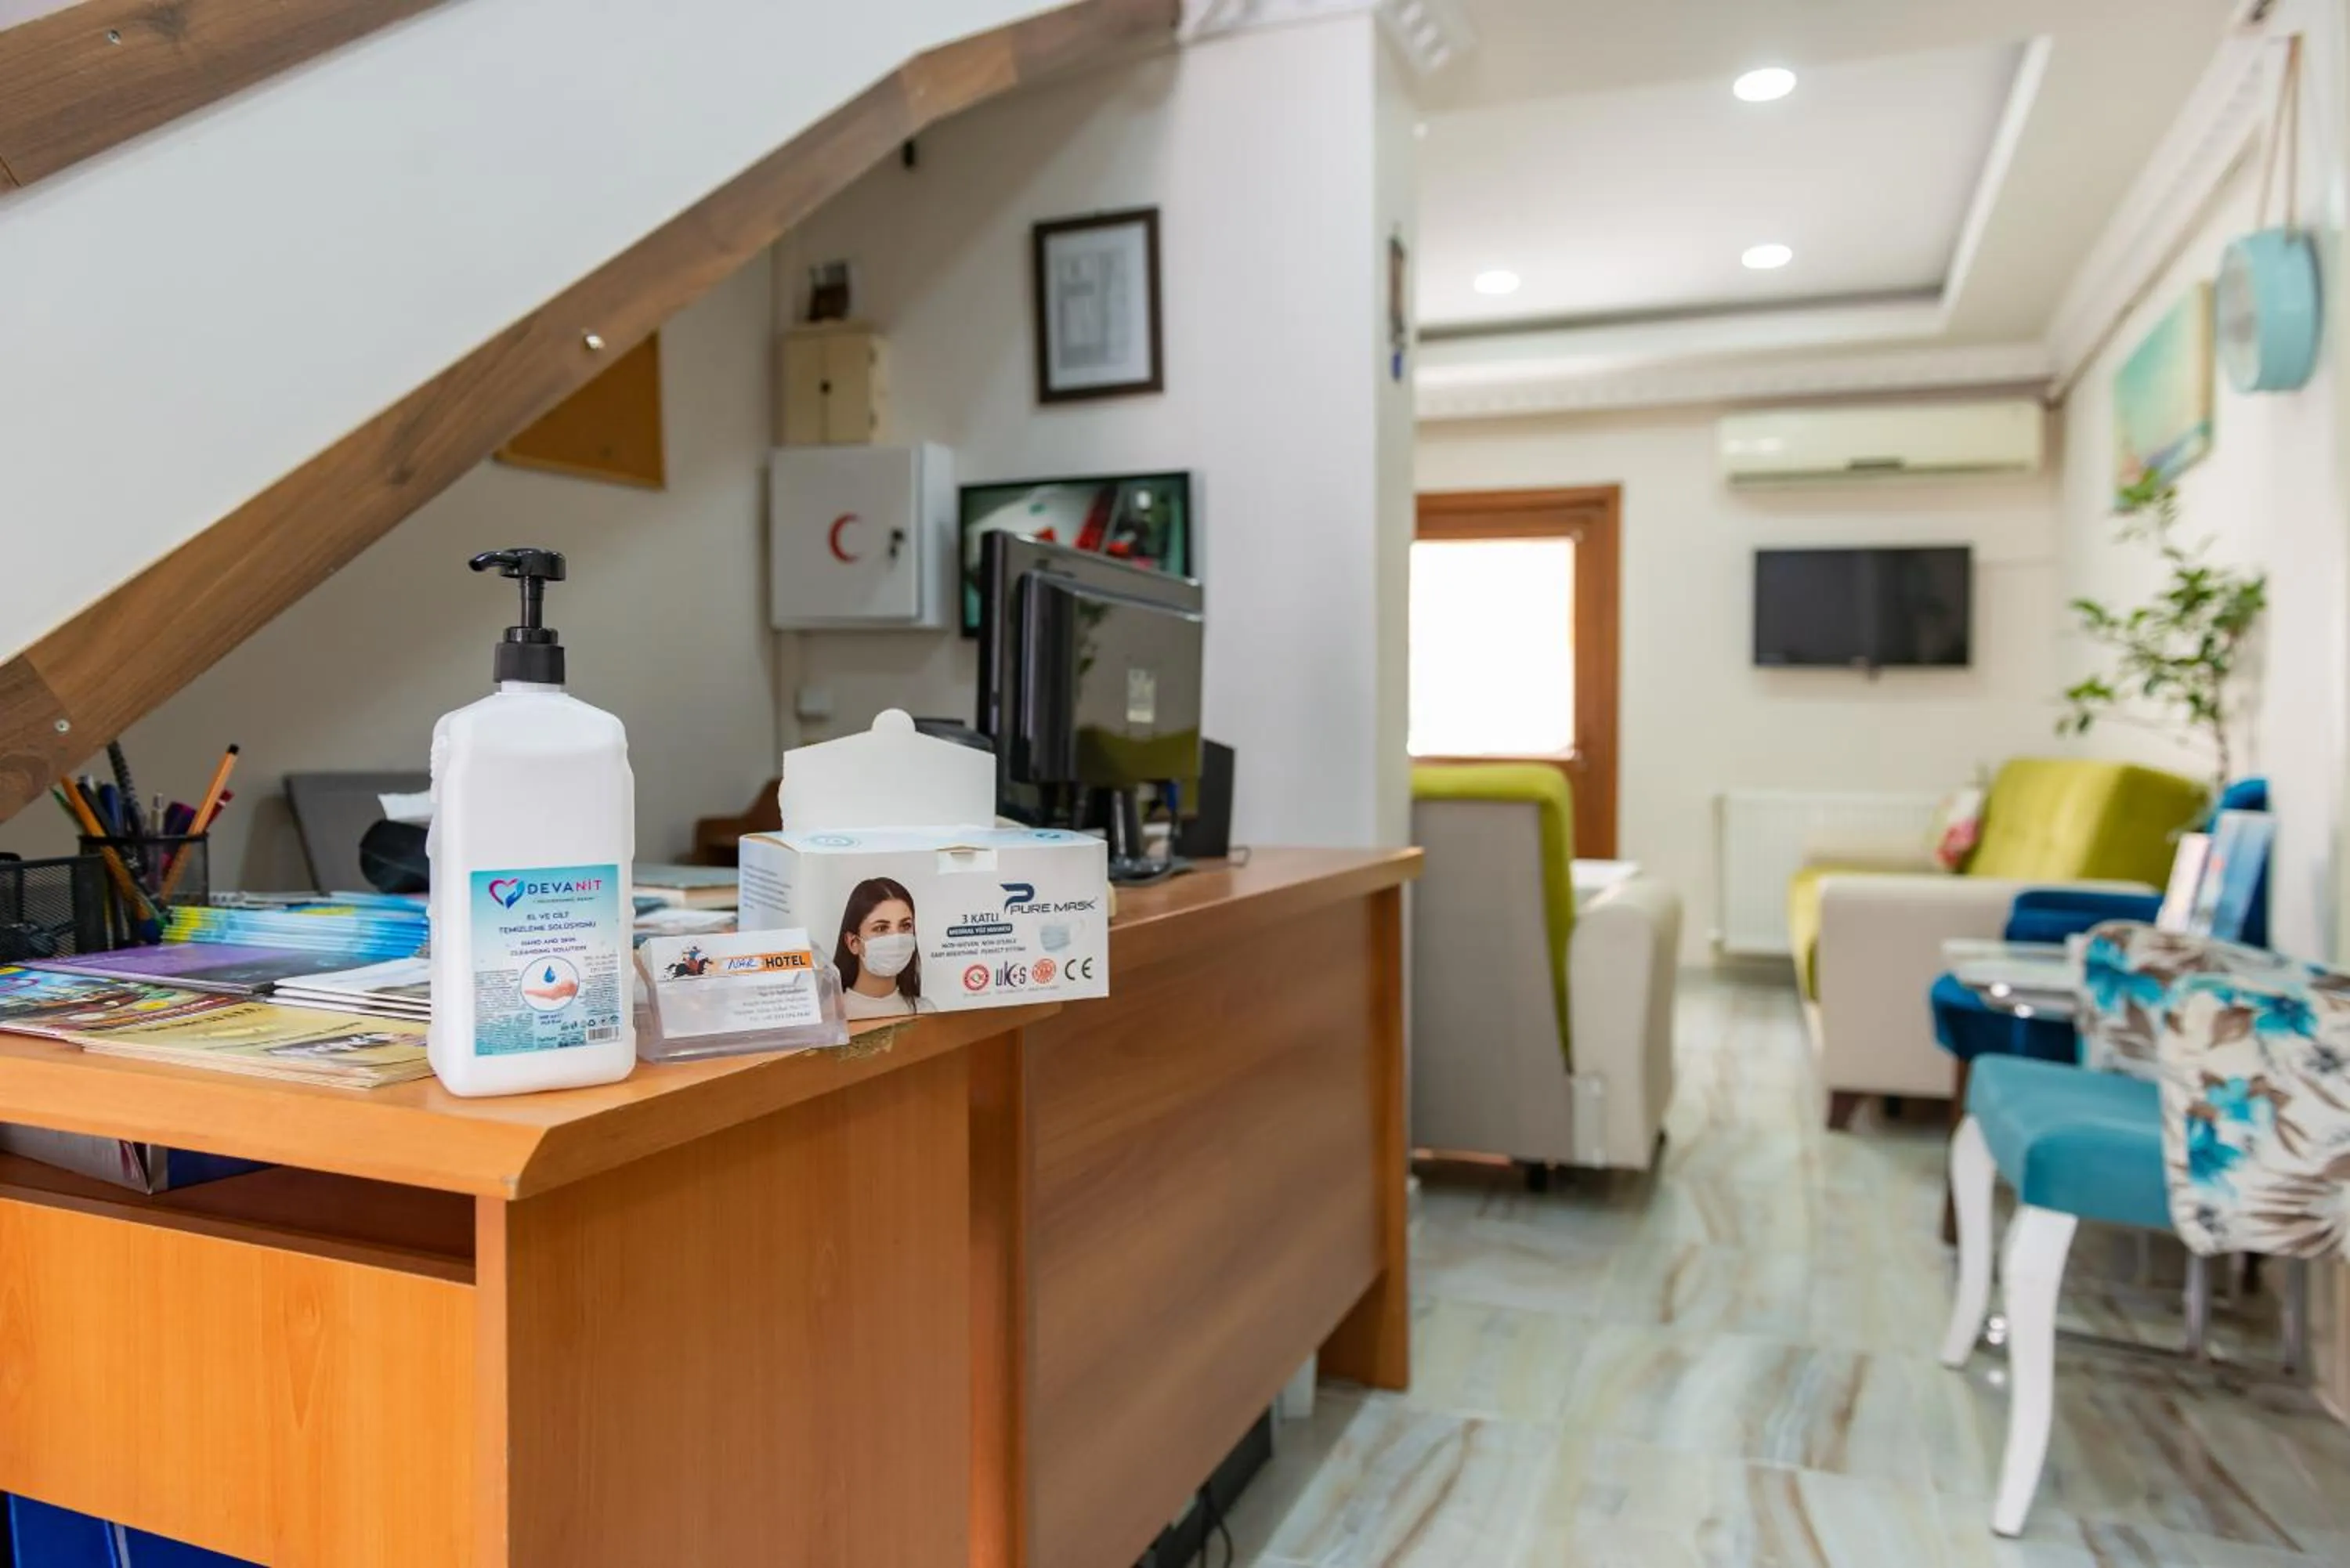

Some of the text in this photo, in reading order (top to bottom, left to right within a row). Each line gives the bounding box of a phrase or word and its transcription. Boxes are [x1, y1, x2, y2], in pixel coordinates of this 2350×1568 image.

[1054, 895, 1098, 912] MASK
[961, 912, 999, 924] 3 KATLI
[765, 955, 805, 968] HOTEL
